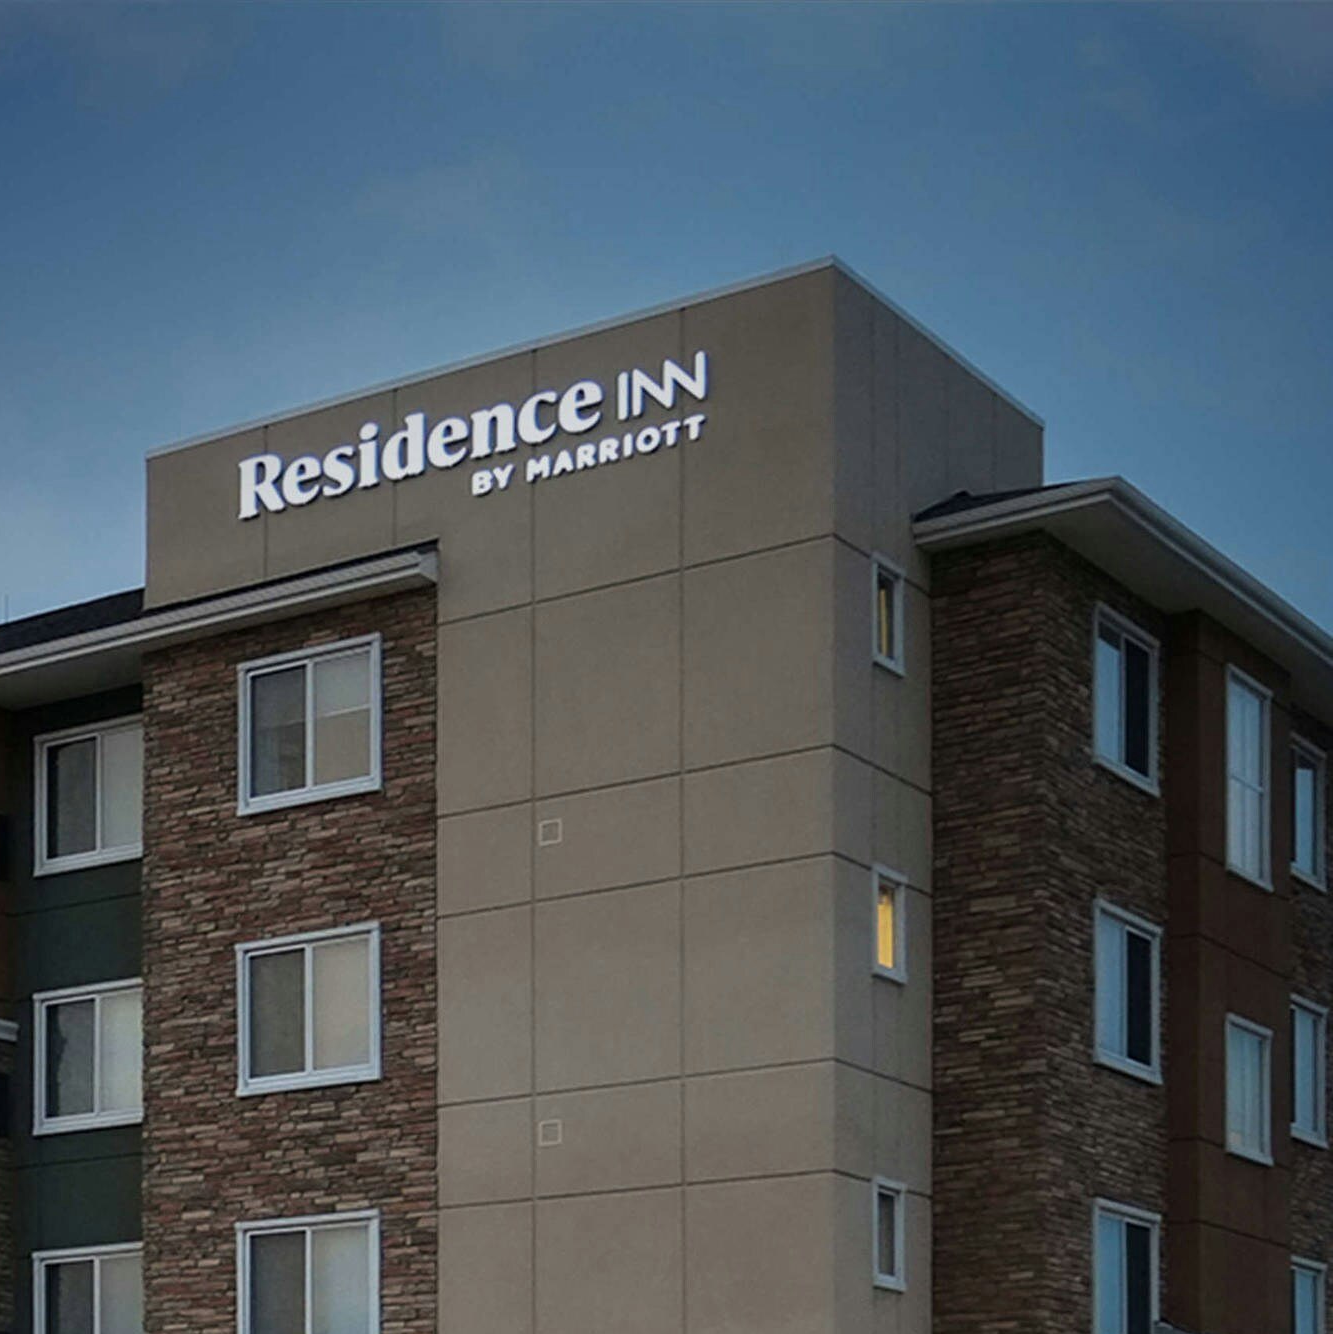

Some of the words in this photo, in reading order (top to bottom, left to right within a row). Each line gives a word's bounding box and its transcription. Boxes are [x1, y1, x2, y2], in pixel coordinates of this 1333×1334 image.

[237, 380, 604, 520] Residence
[617, 350, 708, 421] INN
[470, 463, 515, 496] BY
[526, 413, 706, 483] MARRIOTT
